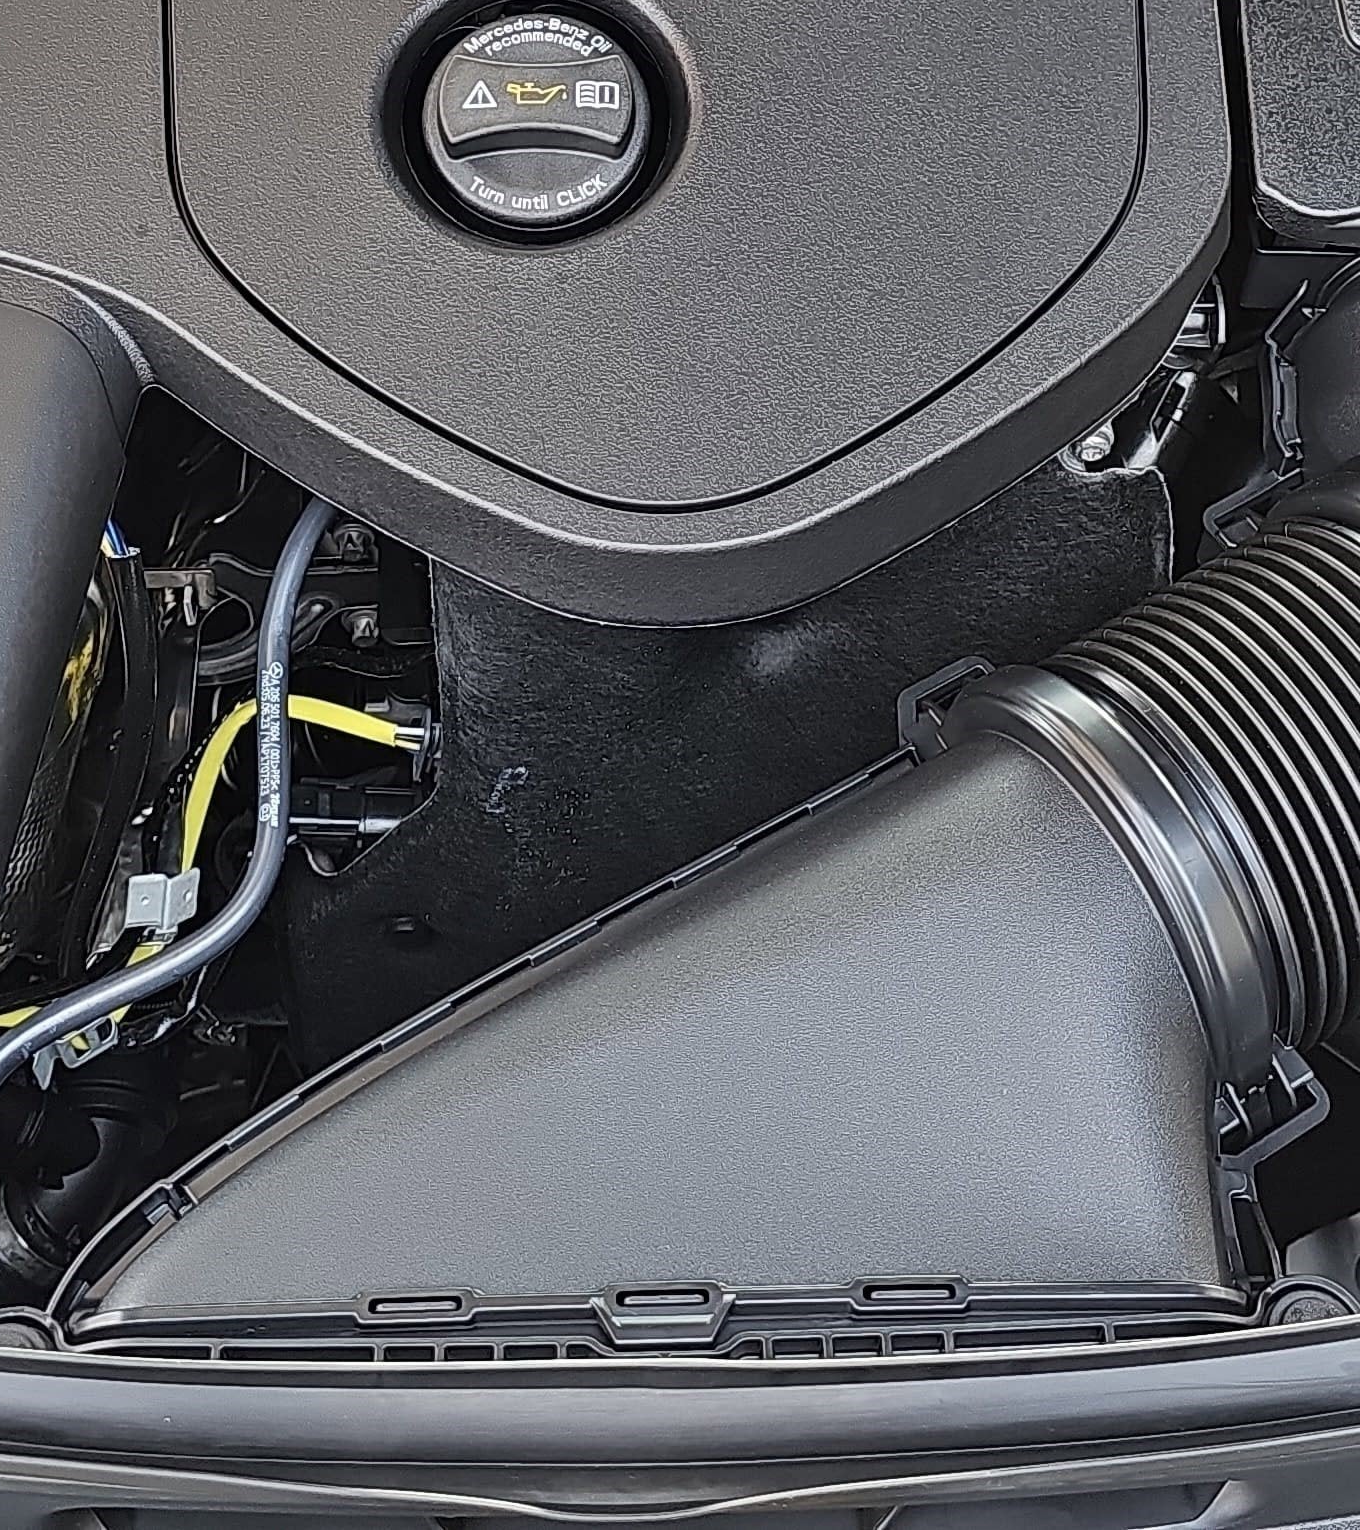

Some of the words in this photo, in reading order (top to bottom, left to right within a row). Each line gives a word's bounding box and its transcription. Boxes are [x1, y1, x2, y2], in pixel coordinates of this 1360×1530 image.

[463, 17, 589, 54] Mercedes-Benz
[590, 34, 613, 54] Oil
[484, 30, 594, 57] recommended
[469, 175, 505, 205] Turn
[511, 194, 548, 210] until
[556, 173, 608, 207] CLICK
